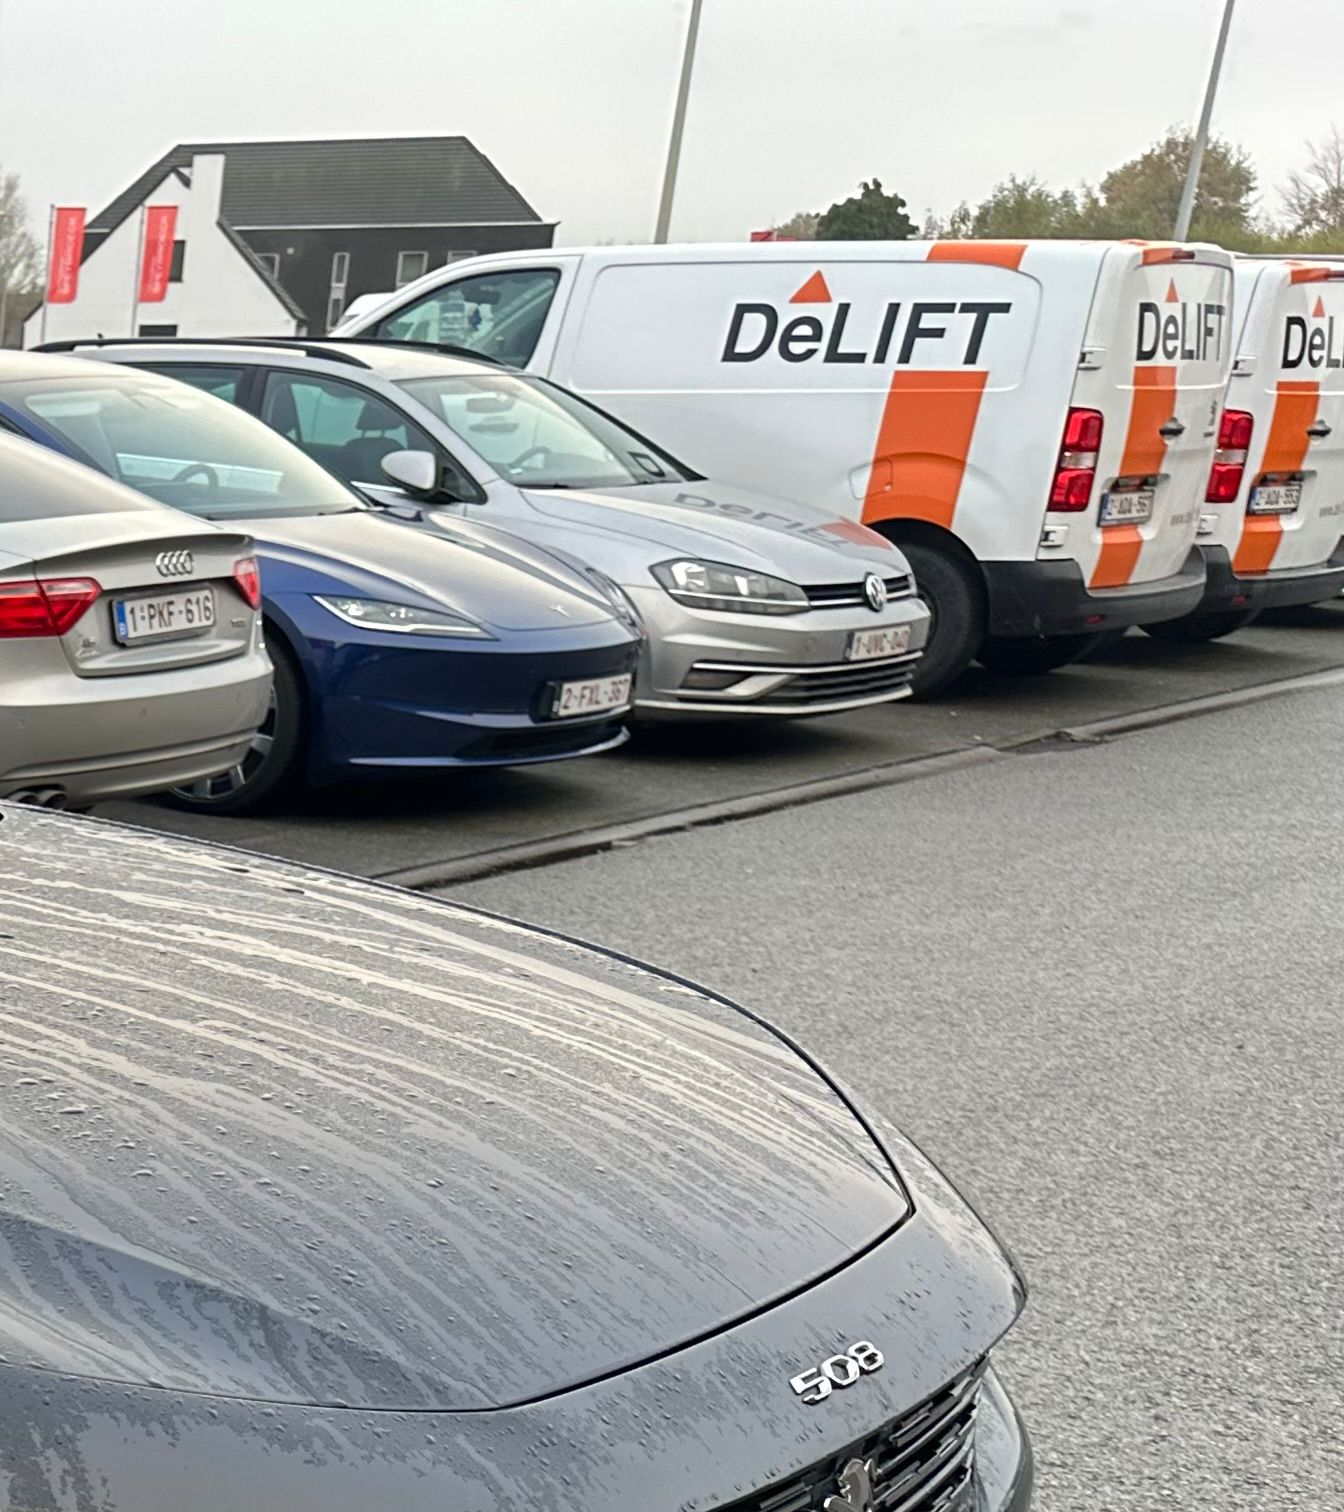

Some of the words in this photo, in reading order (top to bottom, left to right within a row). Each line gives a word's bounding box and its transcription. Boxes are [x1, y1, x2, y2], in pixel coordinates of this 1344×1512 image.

[720, 301, 1013, 365] DeLIFT
[1135, 301, 1226, 361] DeLIFT
[1281, 315, 1344, 369] DeL
[129, 596, 213, 633] 1-PKF-616
[789, 1340, 885, 1405] 508
